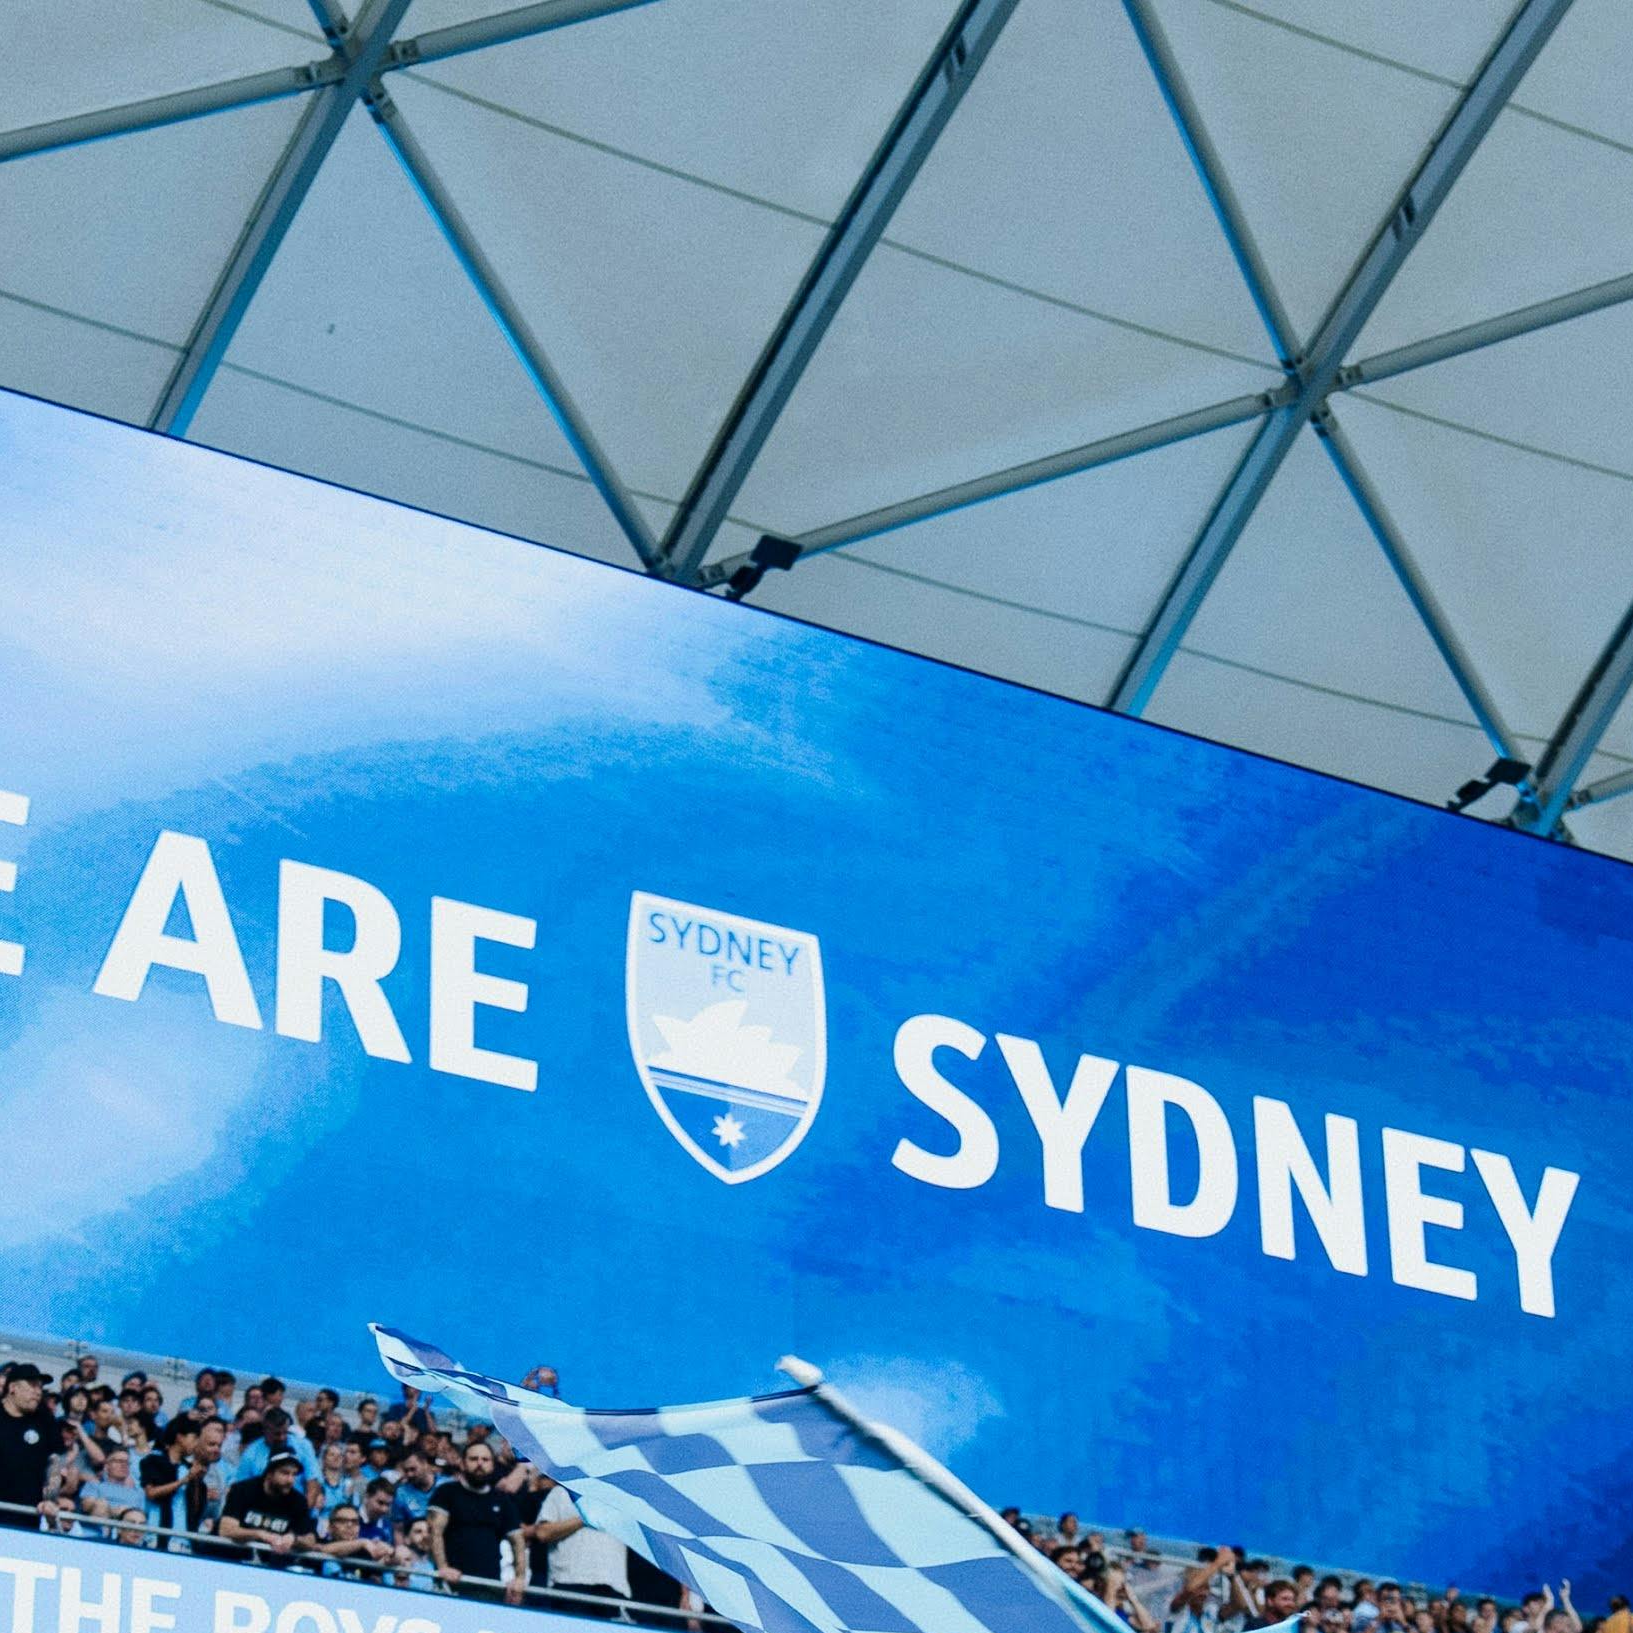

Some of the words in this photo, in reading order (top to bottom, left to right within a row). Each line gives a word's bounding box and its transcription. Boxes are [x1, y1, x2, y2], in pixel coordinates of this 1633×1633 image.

[649, 912, 799, 976] SYDNEY
[712, 964, 746, 993] FC
[94, 831, 536, 1091] ARE
[893, 1016, 1578, 1318] SYDNEY
